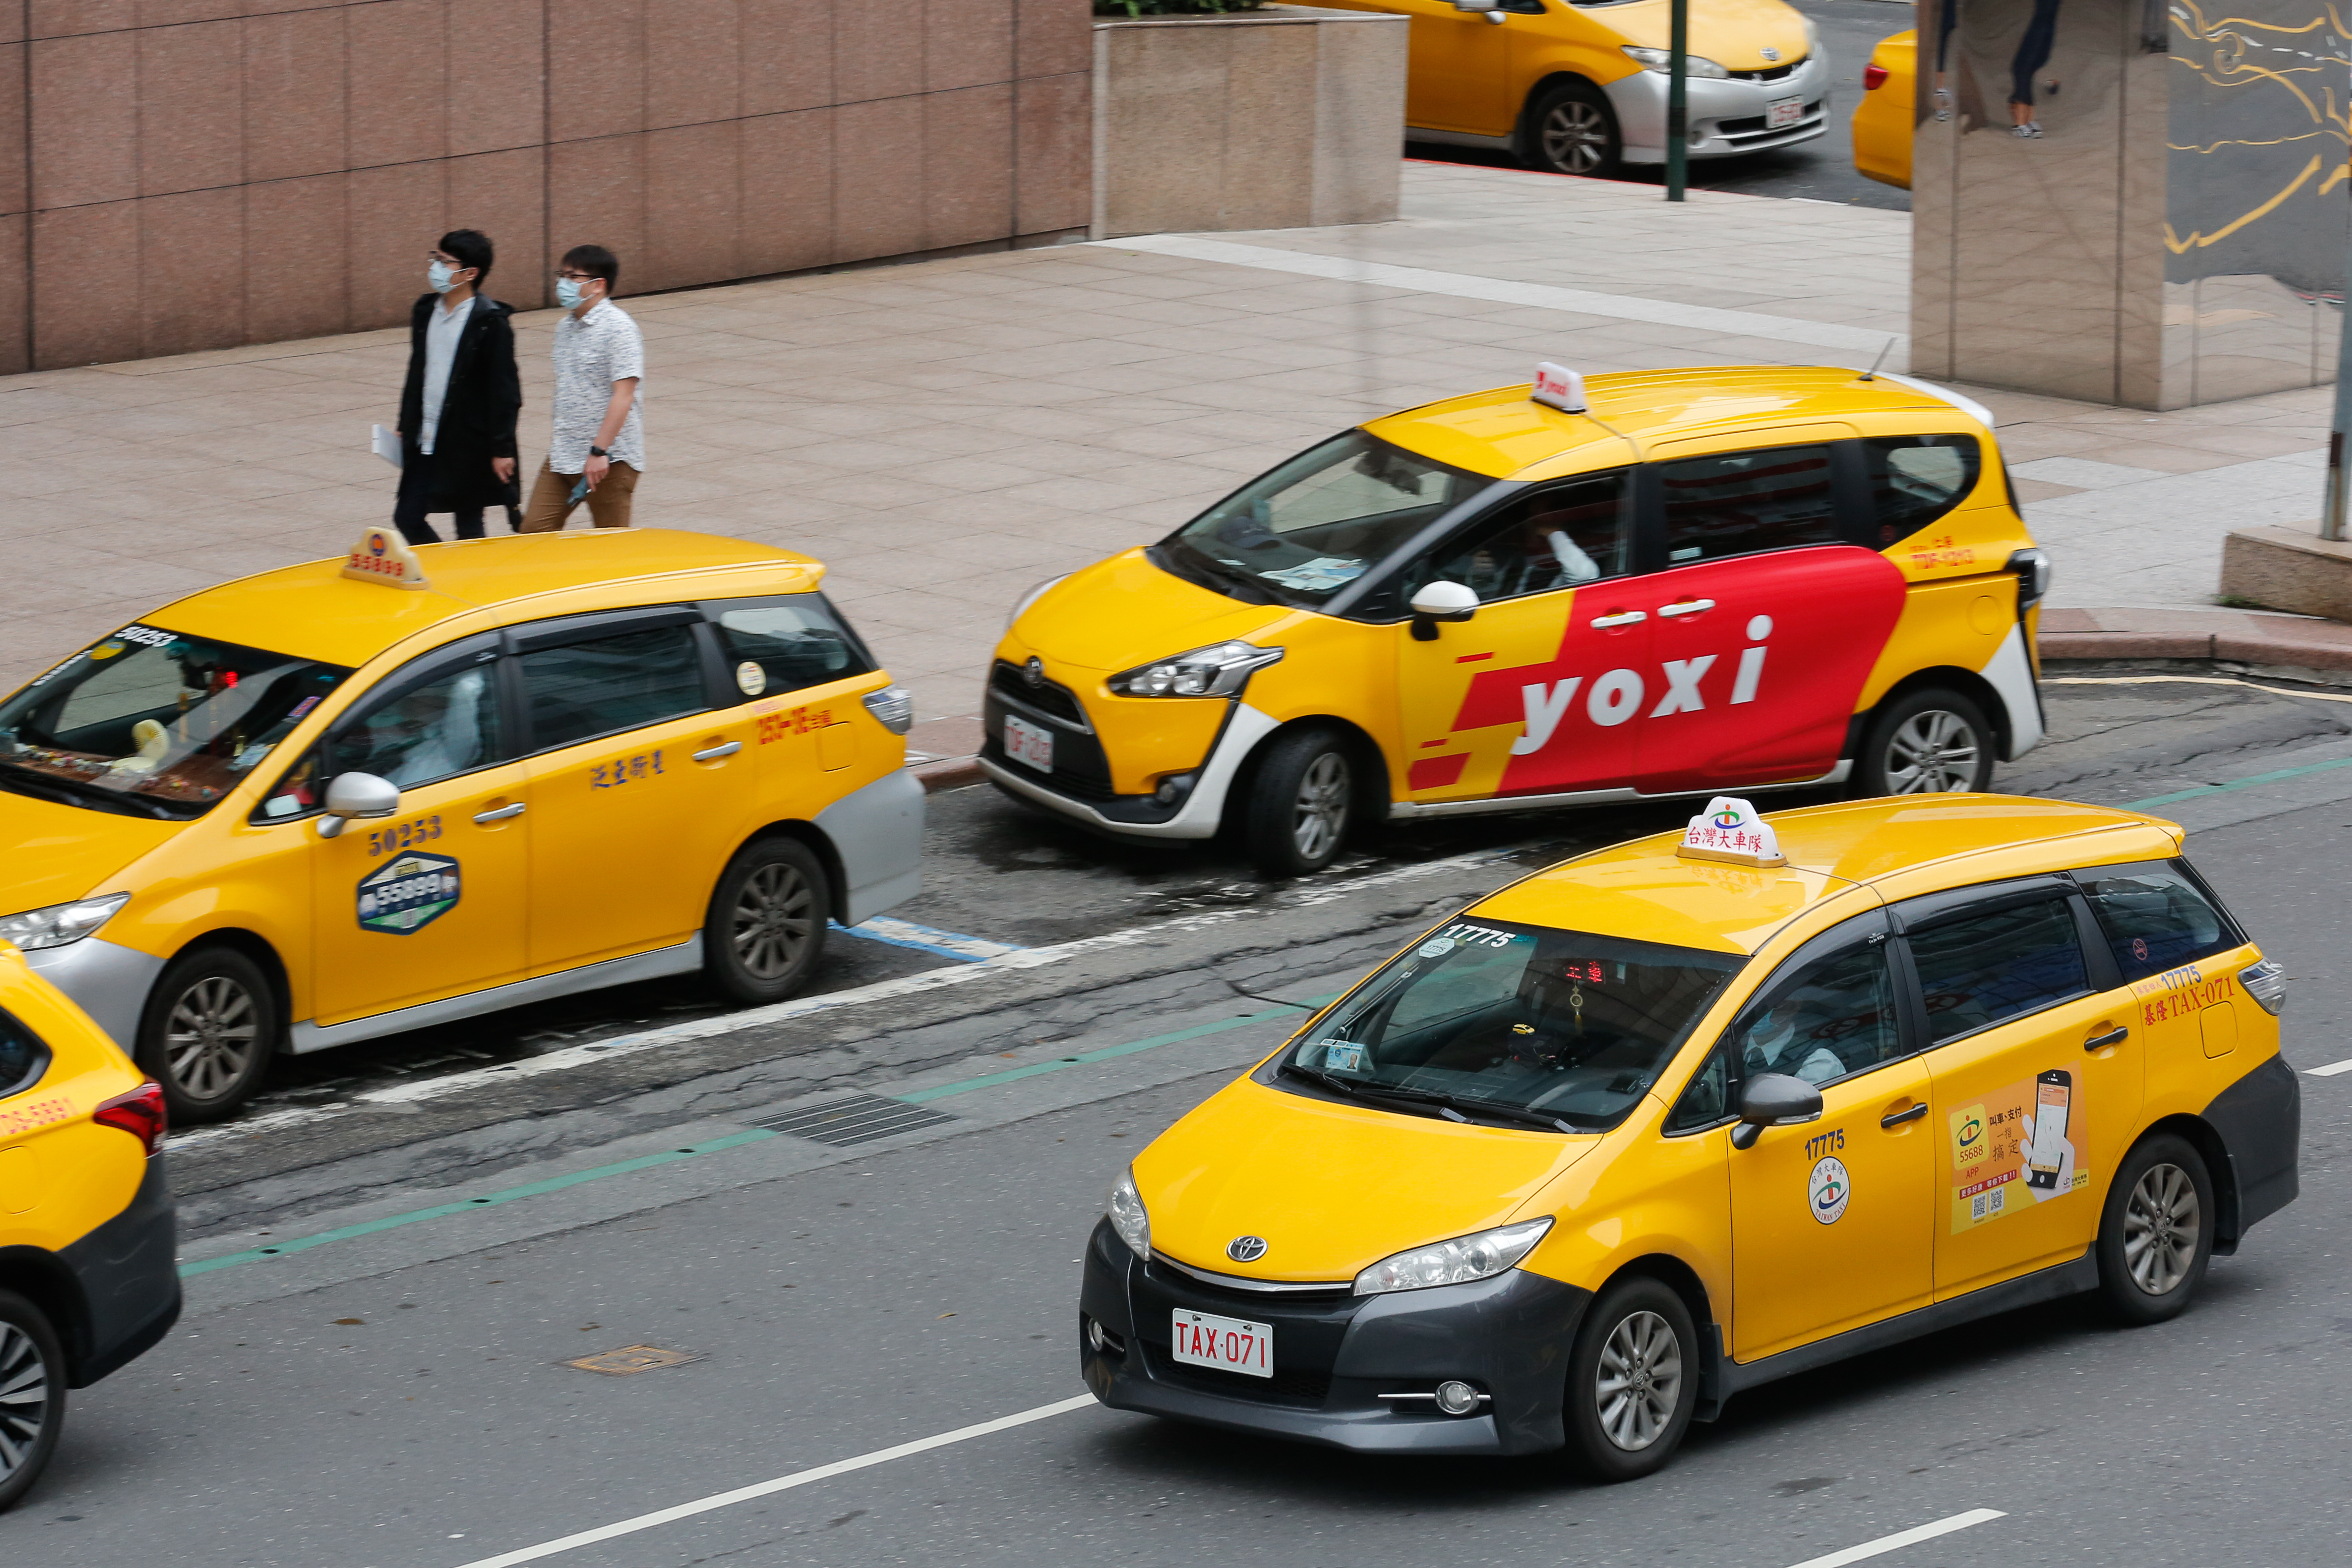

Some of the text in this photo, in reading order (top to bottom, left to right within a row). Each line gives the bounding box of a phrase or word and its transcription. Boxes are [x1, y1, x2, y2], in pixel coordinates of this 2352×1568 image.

[351, 553, 405, 576] 55899
[114, 626, 179, 647] 50253
[1509, 614, 1774, 756] yoxi
[368, 815, 442, 857] 50253
[1689, 826, 1763, 852] 台灣大車隊
[1444, 923, 1516, 948] 17775
[2161, 965, 2201, 991] 17775
[2145, 976, 2235, 1026] 基隆 TAX-071
[1989, 1106, 2021, 1126] 叫車、支付
[1805, 1128, 1845, 1161] 17775
[1997, 1127, 2012, 1139] 一指
[1960, 1145, 1983, 1163] 55688
[1811, 1162, 1844, 1184] 台灣大車隊
[1966, 1167, 1979, 1179] APP
[1815, 1202, 1846, 1221] TAIWAN TAXI
